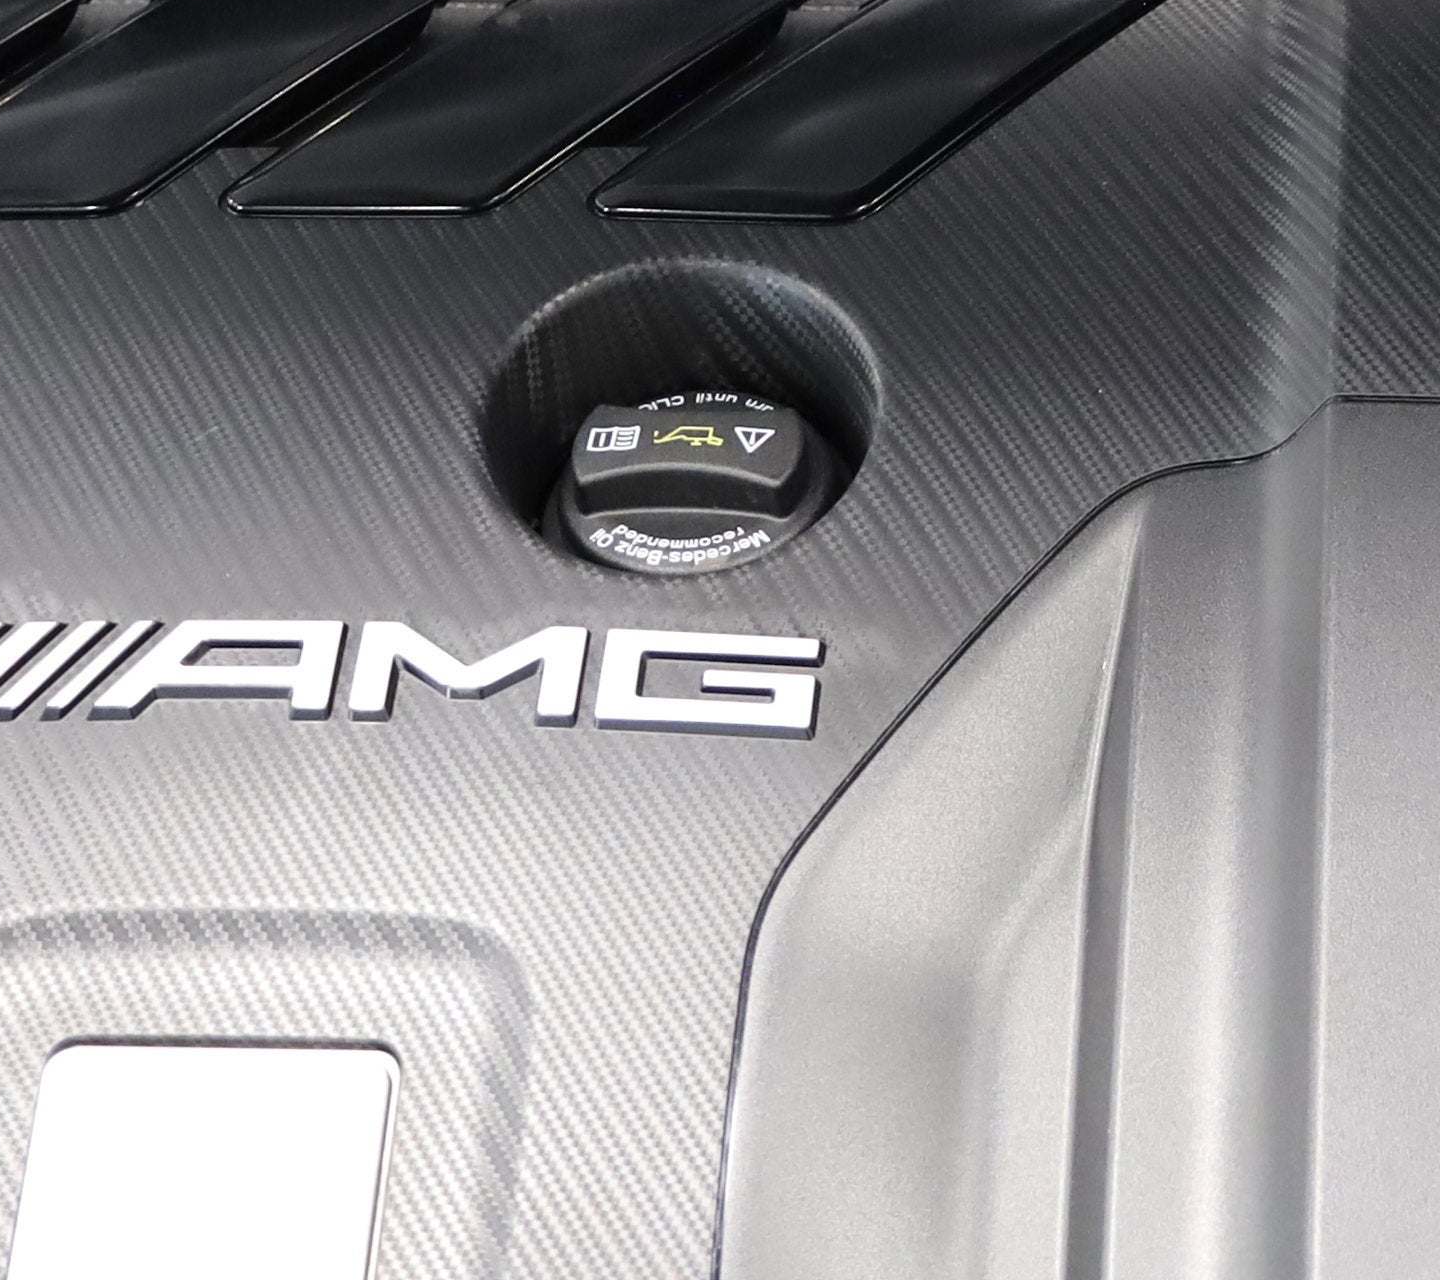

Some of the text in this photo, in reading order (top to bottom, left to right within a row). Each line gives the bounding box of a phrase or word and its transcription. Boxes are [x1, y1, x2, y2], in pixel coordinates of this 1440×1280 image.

[695, 392, 738, 404] until
[588, 527, 771, 565] Mercedes-Benz Oil
[609, 523, 745, 550] recommended
[85, 617, 827, 741] AMG
